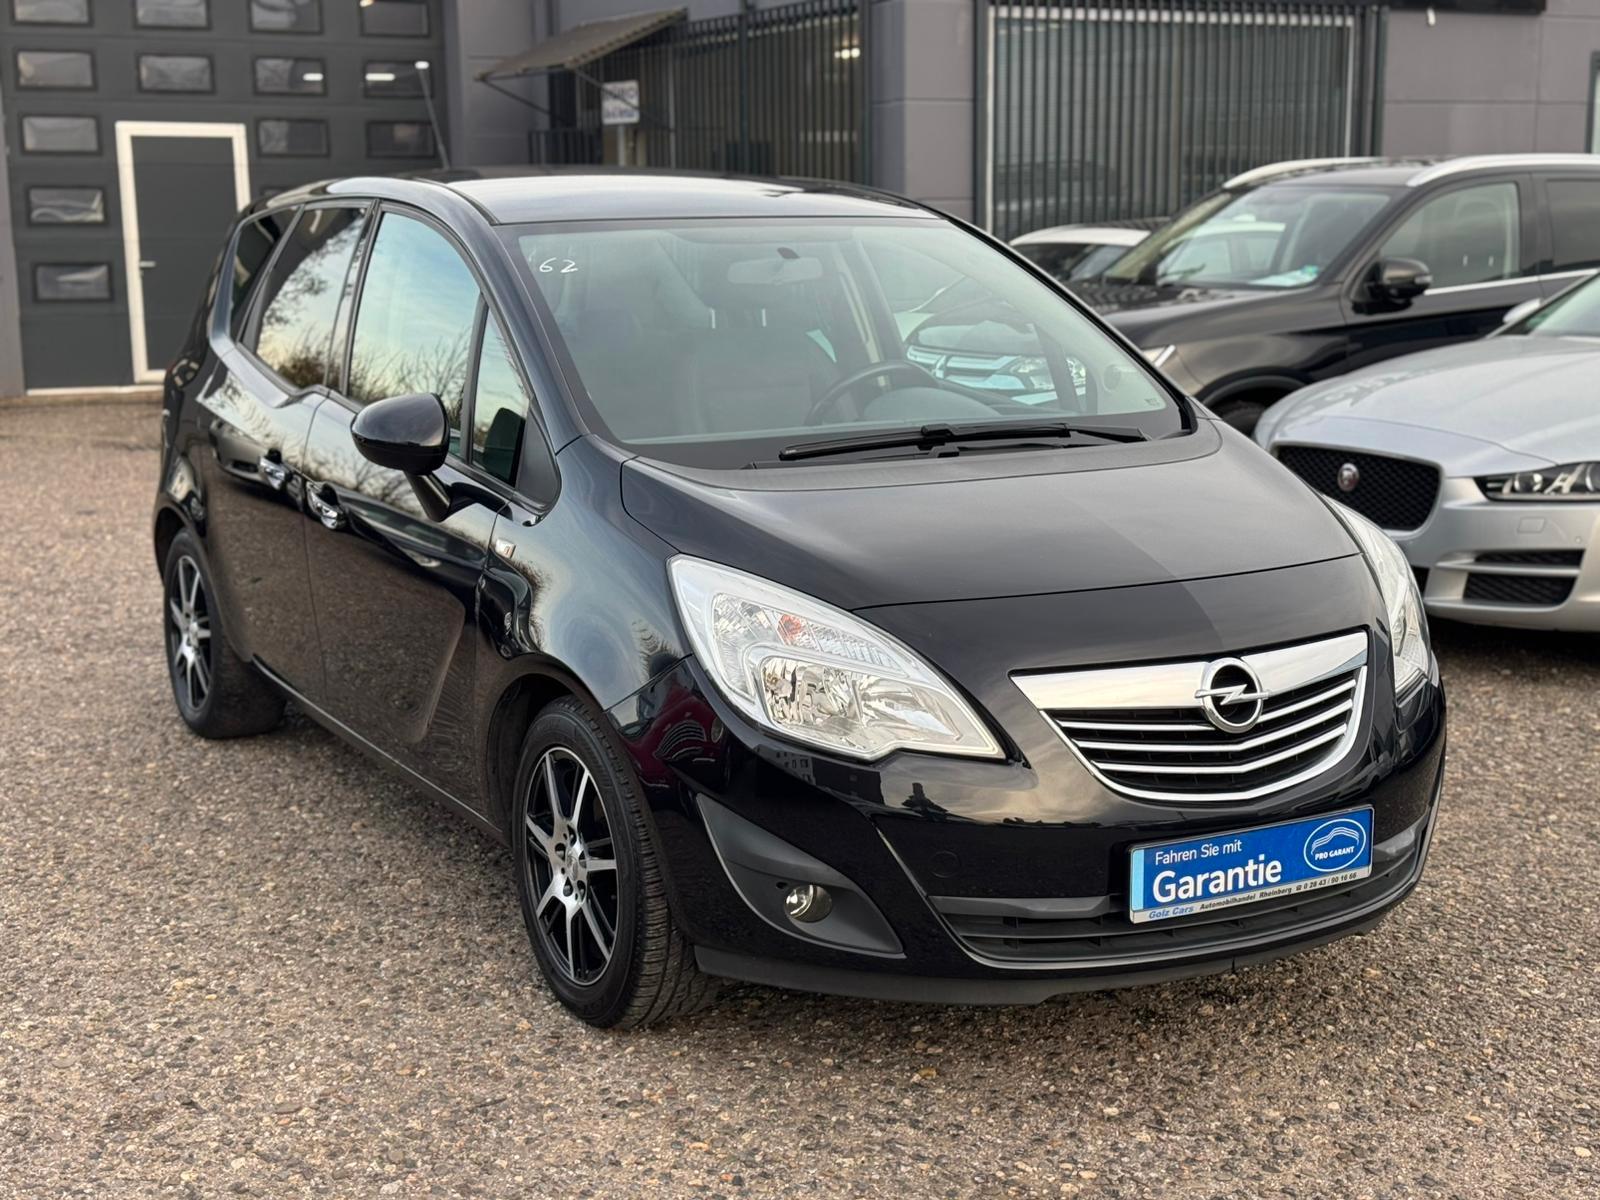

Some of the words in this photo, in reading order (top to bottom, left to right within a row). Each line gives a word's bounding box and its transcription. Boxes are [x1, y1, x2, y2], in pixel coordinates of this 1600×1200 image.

[539, 257, 579, 273] 62
[1155, 849, 1197, 866] Fahren
[1200, 843, 1219, 858] Sie
[1222, 839, 1243, 854] mit
[1314, 852, 1329, 861] PRO
[1329, 846, 1355, 858] GARANT
[1152, 854, 1283, 903] Garantie
[1172, 906, 1194, 916] Cars
[1200, 894, 1256, 910] Automobilhandel
[1259, 887, 1292, 898] Rheinberg
[1309, 881, 1318, 889] 28
[1318, 879, 1327, 887] 43
